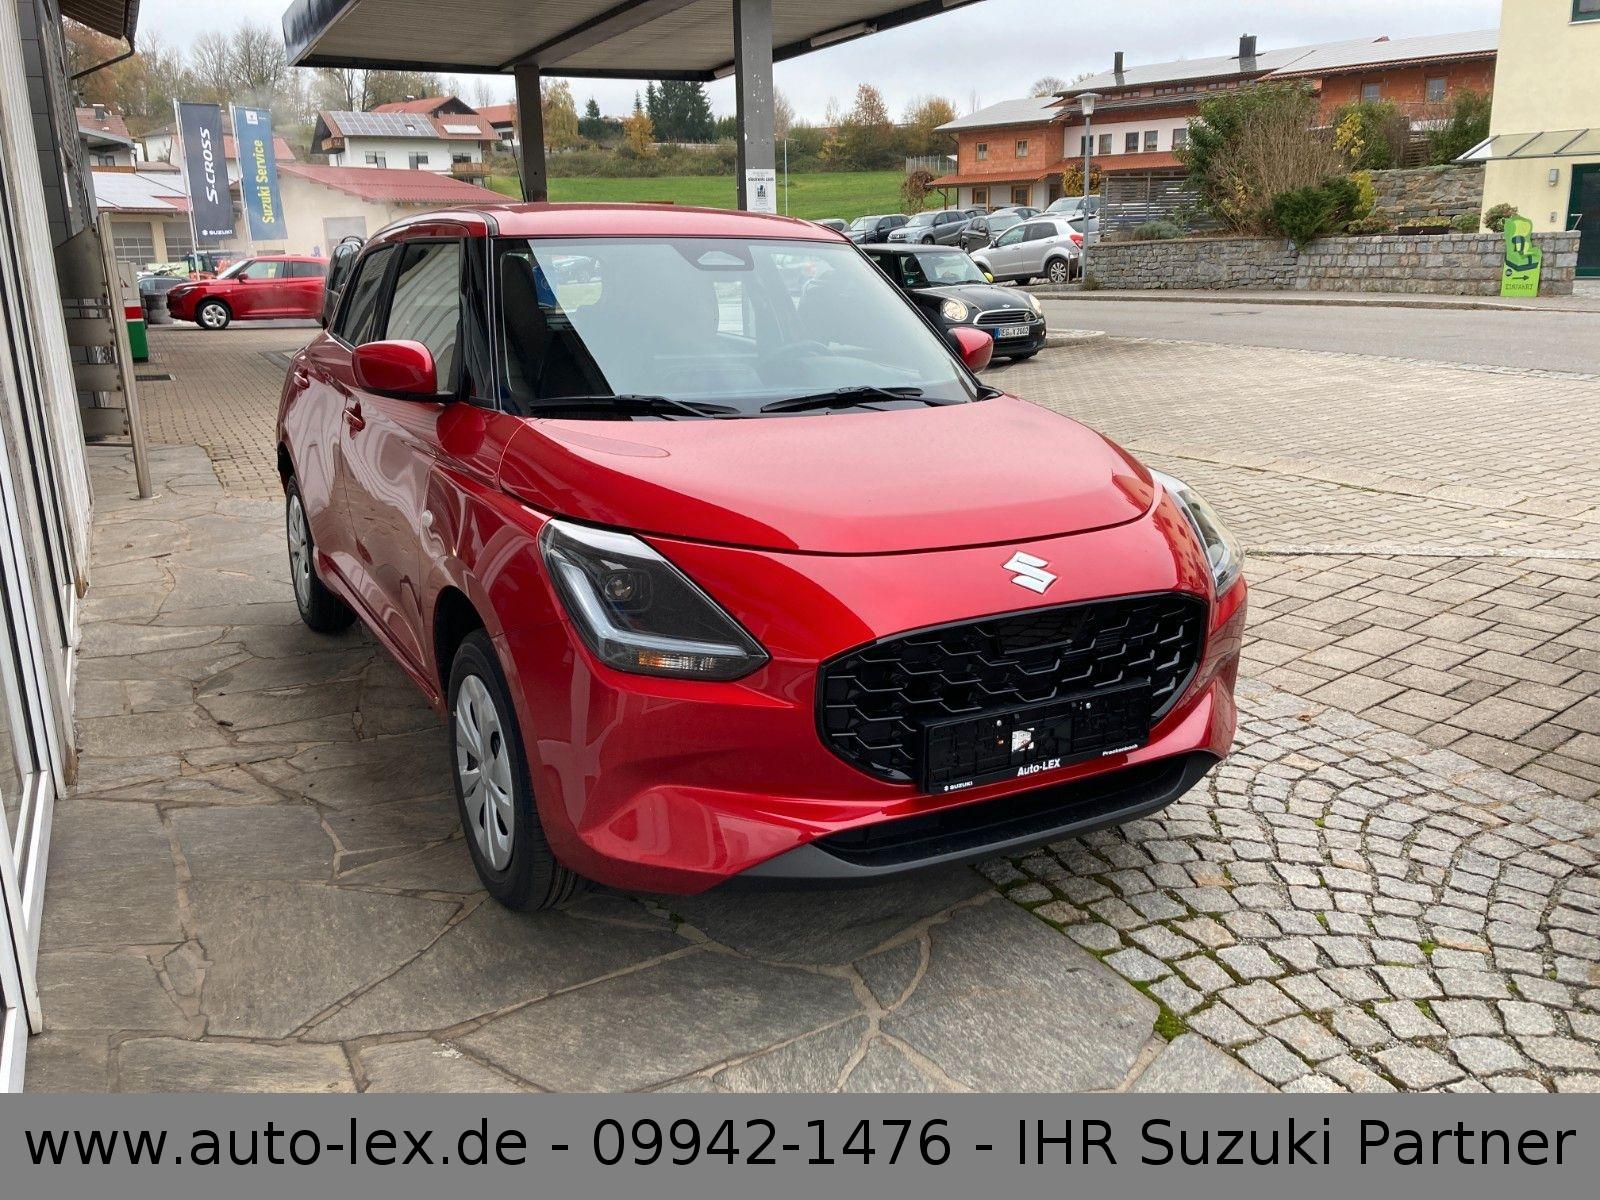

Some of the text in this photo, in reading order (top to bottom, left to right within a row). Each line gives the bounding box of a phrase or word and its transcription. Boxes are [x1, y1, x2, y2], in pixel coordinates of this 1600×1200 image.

[252, 139, 269, 183] Service
[256, 185, 275, 224] Suzuki
[1017, 758, 1061, 777] Auto-LEX
[949, 780, 973, 790] SUZUKI
